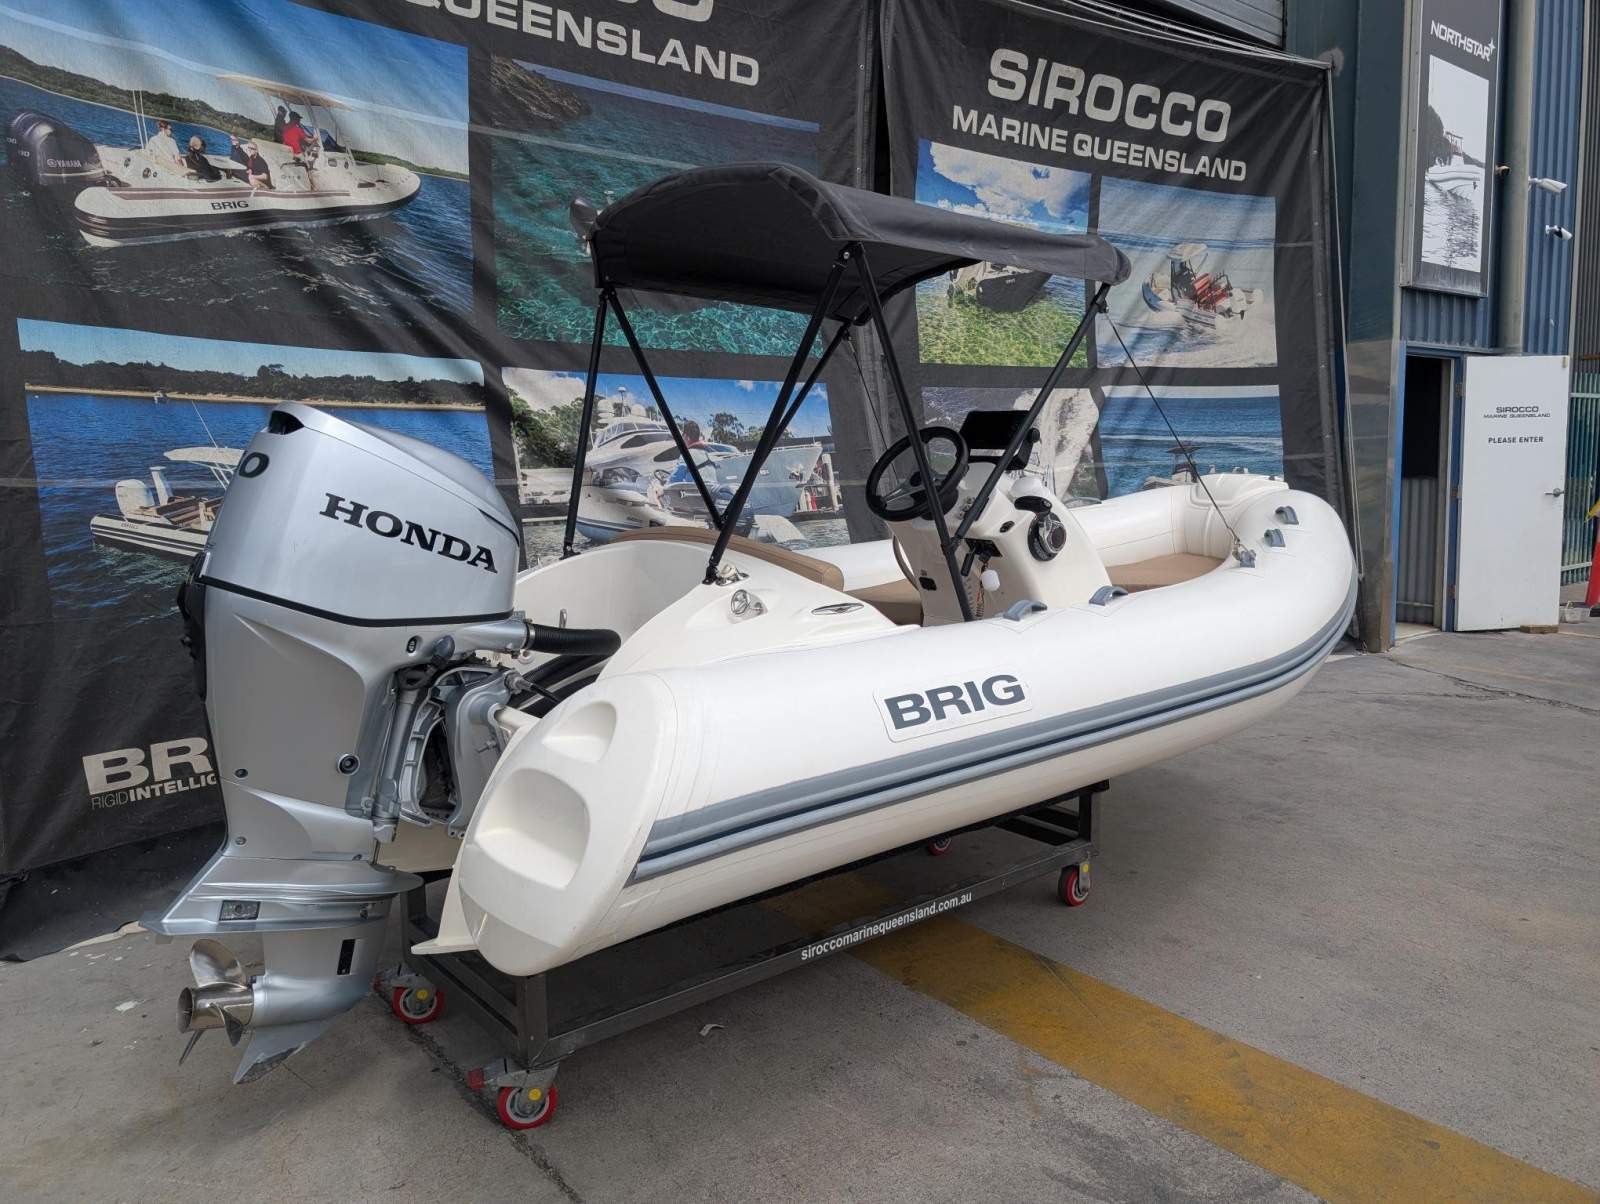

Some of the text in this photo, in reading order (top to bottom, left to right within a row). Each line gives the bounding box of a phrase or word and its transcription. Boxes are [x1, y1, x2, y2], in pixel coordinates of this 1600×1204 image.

[1430, 20, 1491, 62] NORTHSTAR
[987, 48, 1232, 143] SIROCCO
[952, 105, 1247, 182] MARINE QUEENSLAND
[211, 200, 249, 211] BRIG
[320, 493, 498, 574] HONDA
[884, 674, 1026, 730] BRIG
[801, 893, 972, 960] siroccomarinequeensland.com.au
